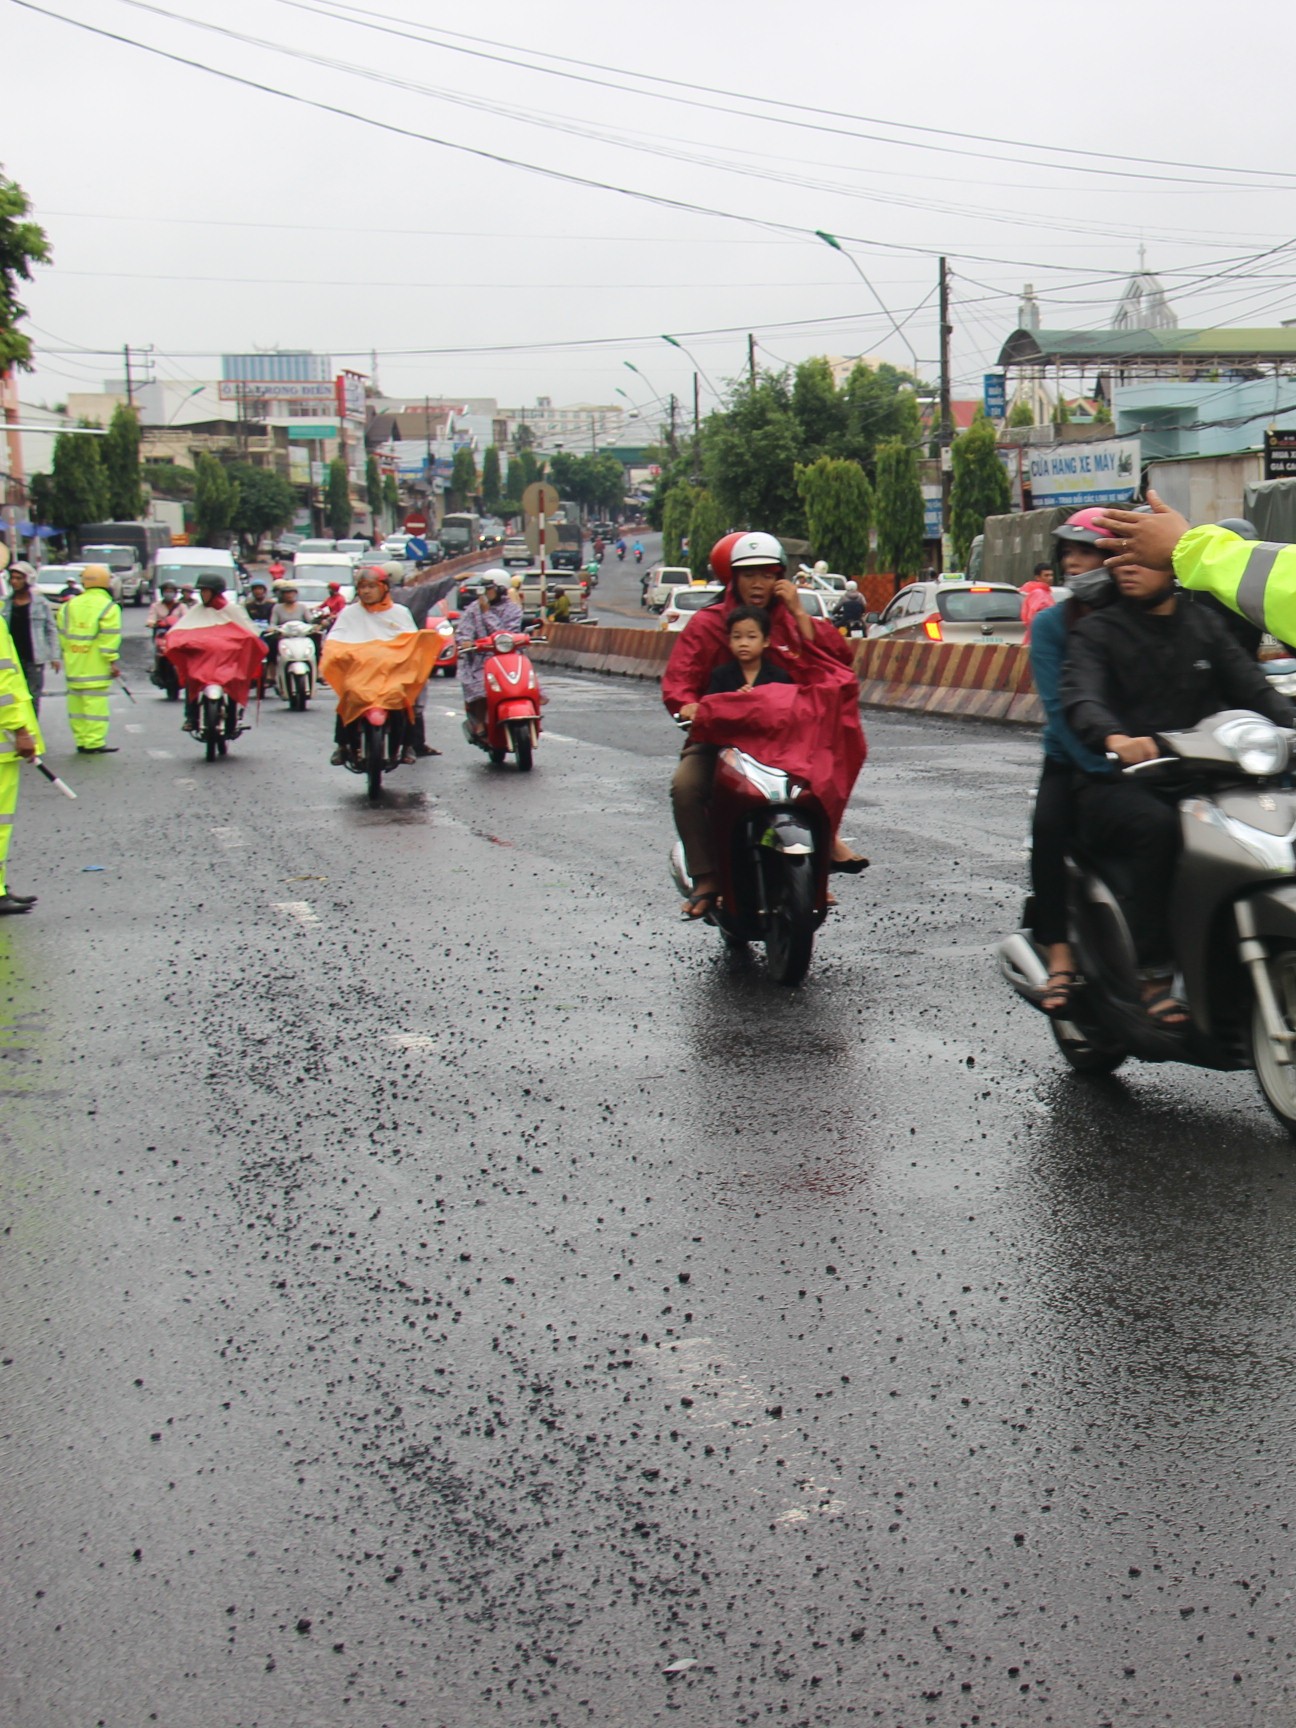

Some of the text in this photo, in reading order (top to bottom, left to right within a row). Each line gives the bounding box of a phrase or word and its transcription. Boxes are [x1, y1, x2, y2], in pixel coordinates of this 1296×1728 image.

[1079, 455, 1091, 473] XE
[1094, 448, 1116, 472] MÁY
[1271, 451, 1289, 459] MUA
